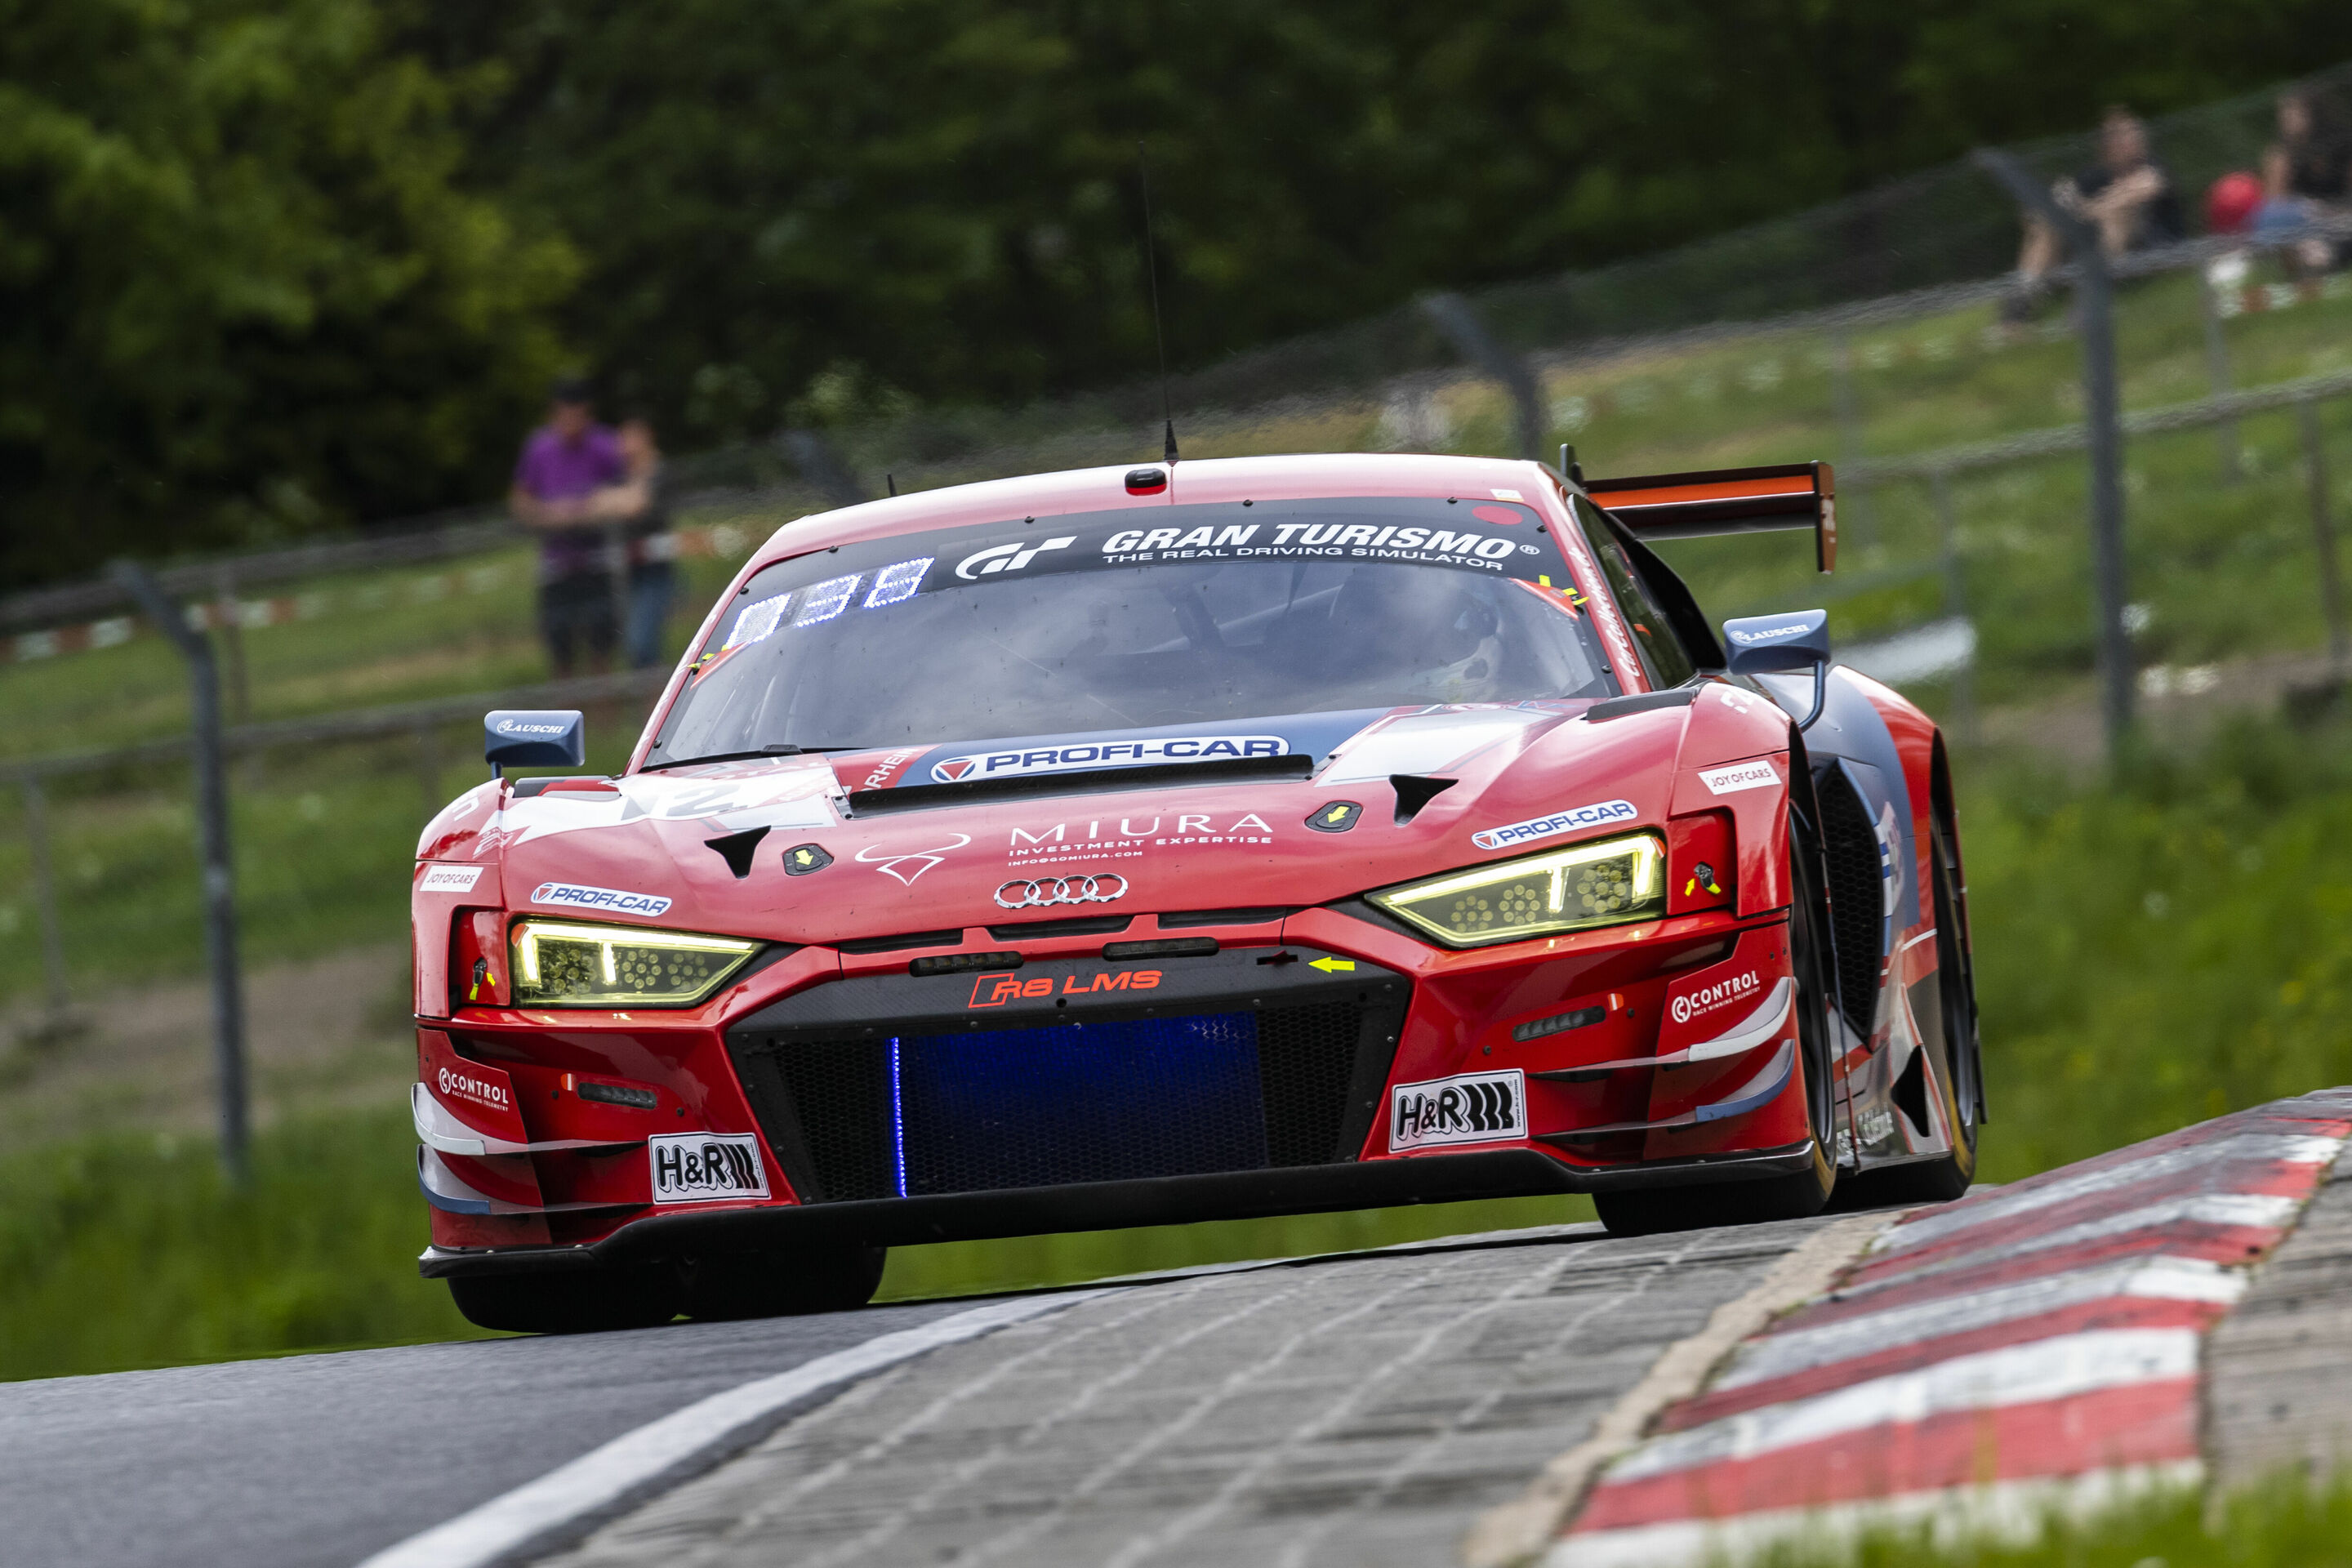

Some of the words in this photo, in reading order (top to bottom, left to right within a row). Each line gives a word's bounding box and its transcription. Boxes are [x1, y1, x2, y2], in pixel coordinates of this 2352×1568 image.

[1102, 524, 1260, 554] GRAN
[1102, 552, 1154, 564] THE
[1161, 549, 1229, 560] REAL
[1234, 546, 1343, 557] DRIVING
[1350, 547, 1503, 571] SIMULATOR
[986, 739, 1281, 772] PROFI-CAR
[1010, 813, 1273, 846] MIURA
[1495, 802, 1635, 842] PROFI-CAR
[1008, 850, 1143, 866] INFO@GOMIURA.COM
[1009, 839, 1145, 857] INVESTMENT
[1156, 835, 1272, 846] EXPERTISE
[550, 887, 668, 913] PROFI-CAR
[990, 977, 1053, 1002] R8
[1063, 970, 1163, 994] LMS
[1690, 970, 1760, 1009] CONTROL
[451, 1073, 509, 1104] CONTROL
[1397, 1089, 1463, 1137] H&R
[657, 1145, 728, 1187] H&R
